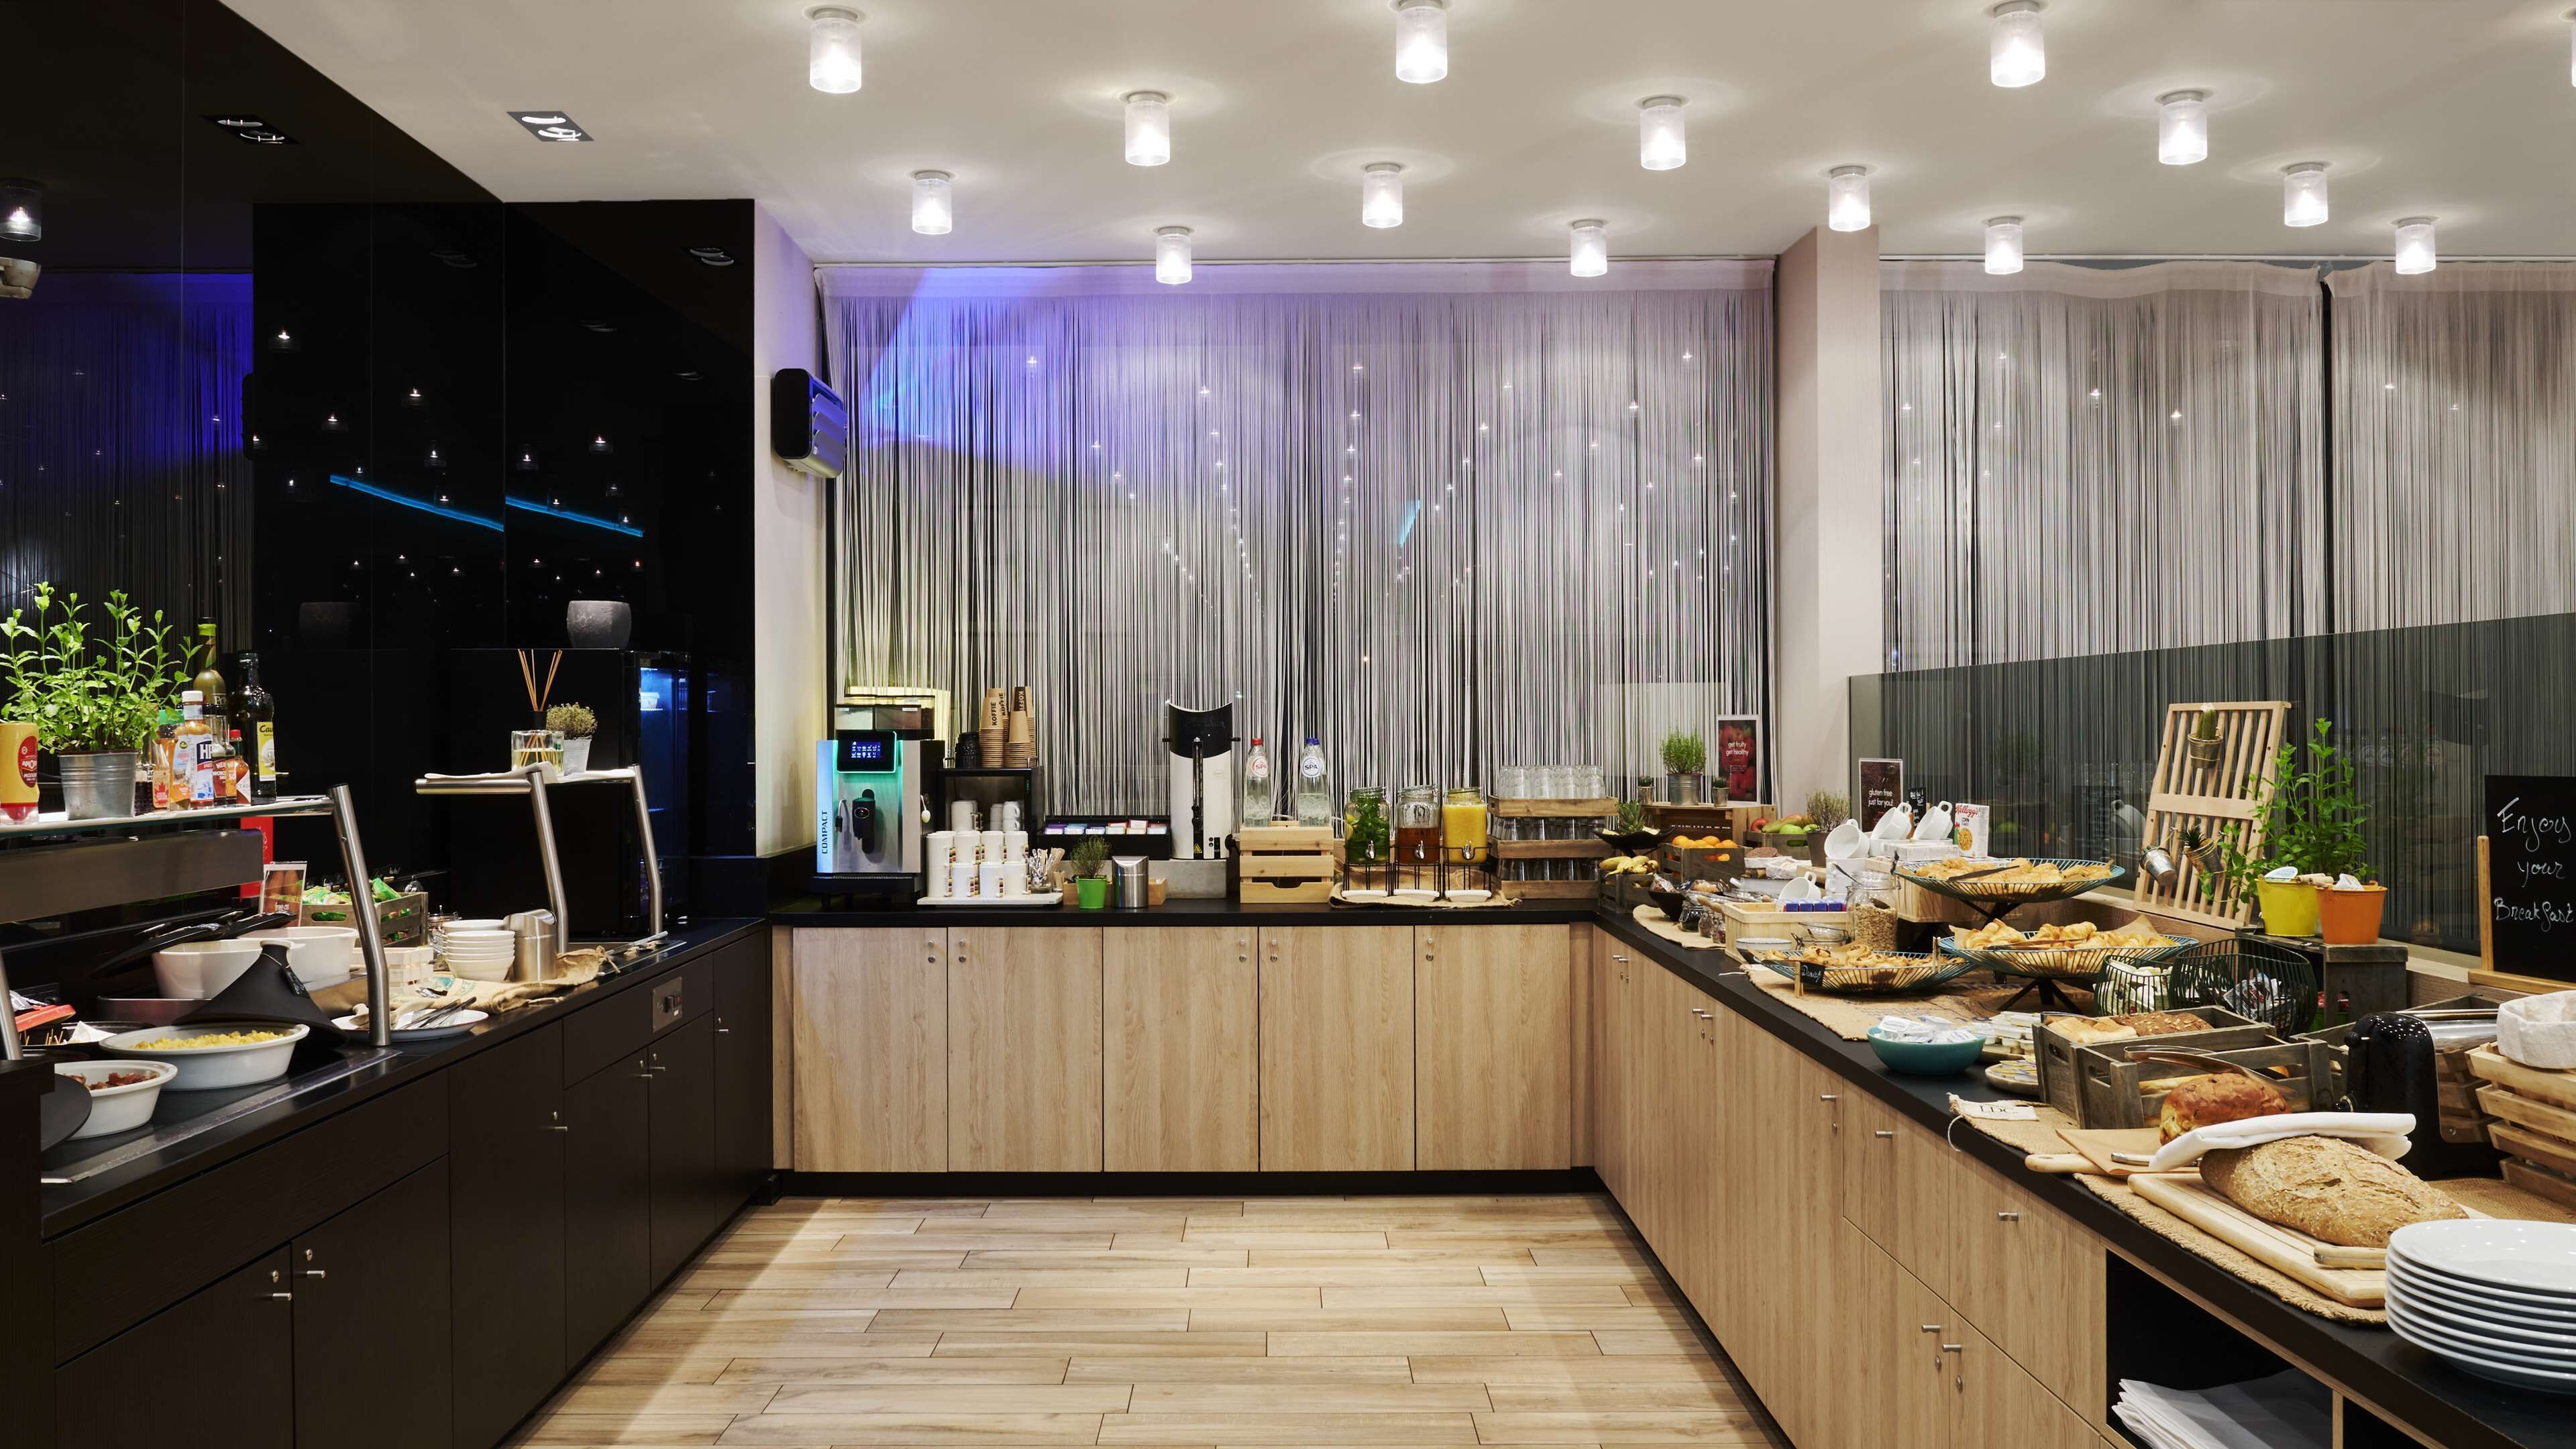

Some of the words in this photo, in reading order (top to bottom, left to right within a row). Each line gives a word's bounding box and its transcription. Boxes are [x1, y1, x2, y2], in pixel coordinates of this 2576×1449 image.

[1735, 741, 1746, 749] fruity
[1733, 749, 1749, 757] healthy
[1868, 788, 1883, 798] gluten
[1883, 788, 1893, 797] free
[1868, 798, 1876, 807] just
[1955, 804, 1979, 818] Kellogg's
[2497, 796, 2571, 852] Enjoy
[2517, 861, 2566, 888] your
[2493, 896, 2574, 932] Breakfast
